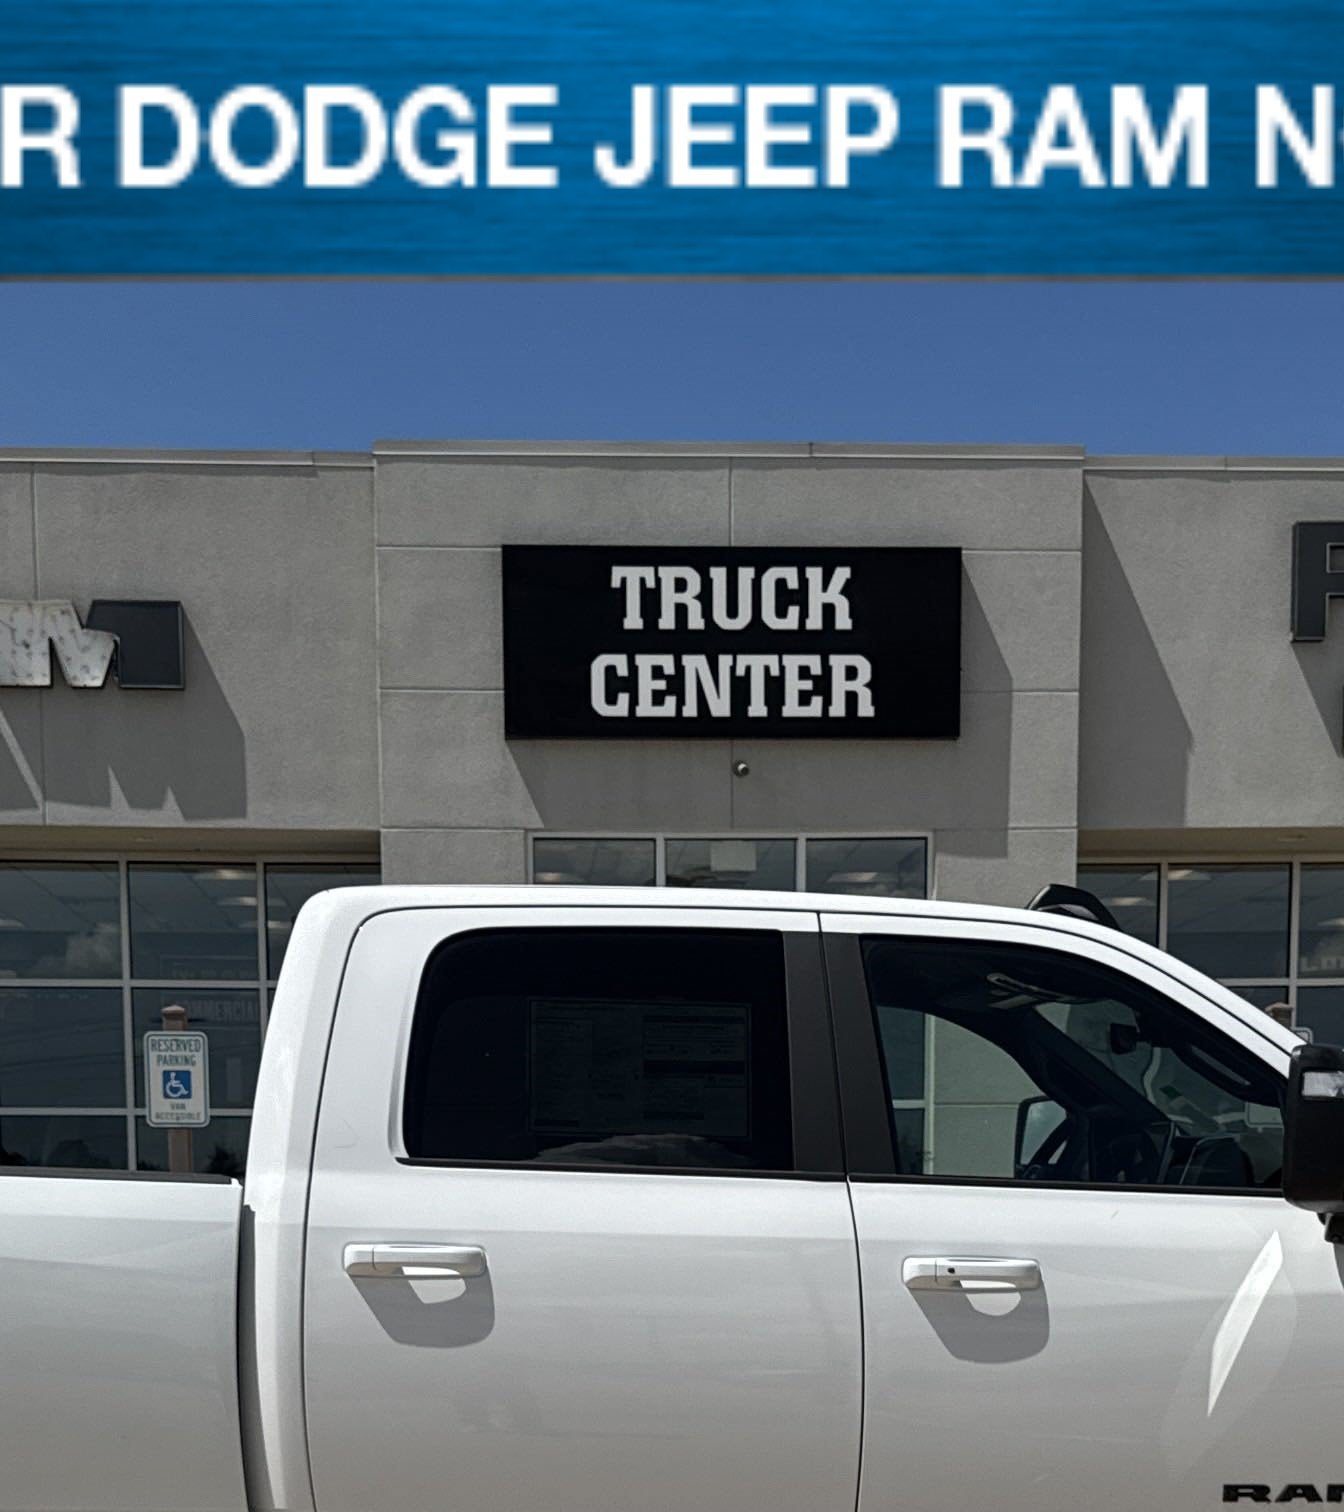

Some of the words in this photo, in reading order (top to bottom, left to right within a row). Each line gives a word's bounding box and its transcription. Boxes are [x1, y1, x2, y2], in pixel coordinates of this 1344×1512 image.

[610, 565, 853, 631] TRUCK
[590, 653, 875, 719] CENTER
[151, 1038, 202, 1053] RESERVED
[156, 1053, 197, 1067] PARKING
